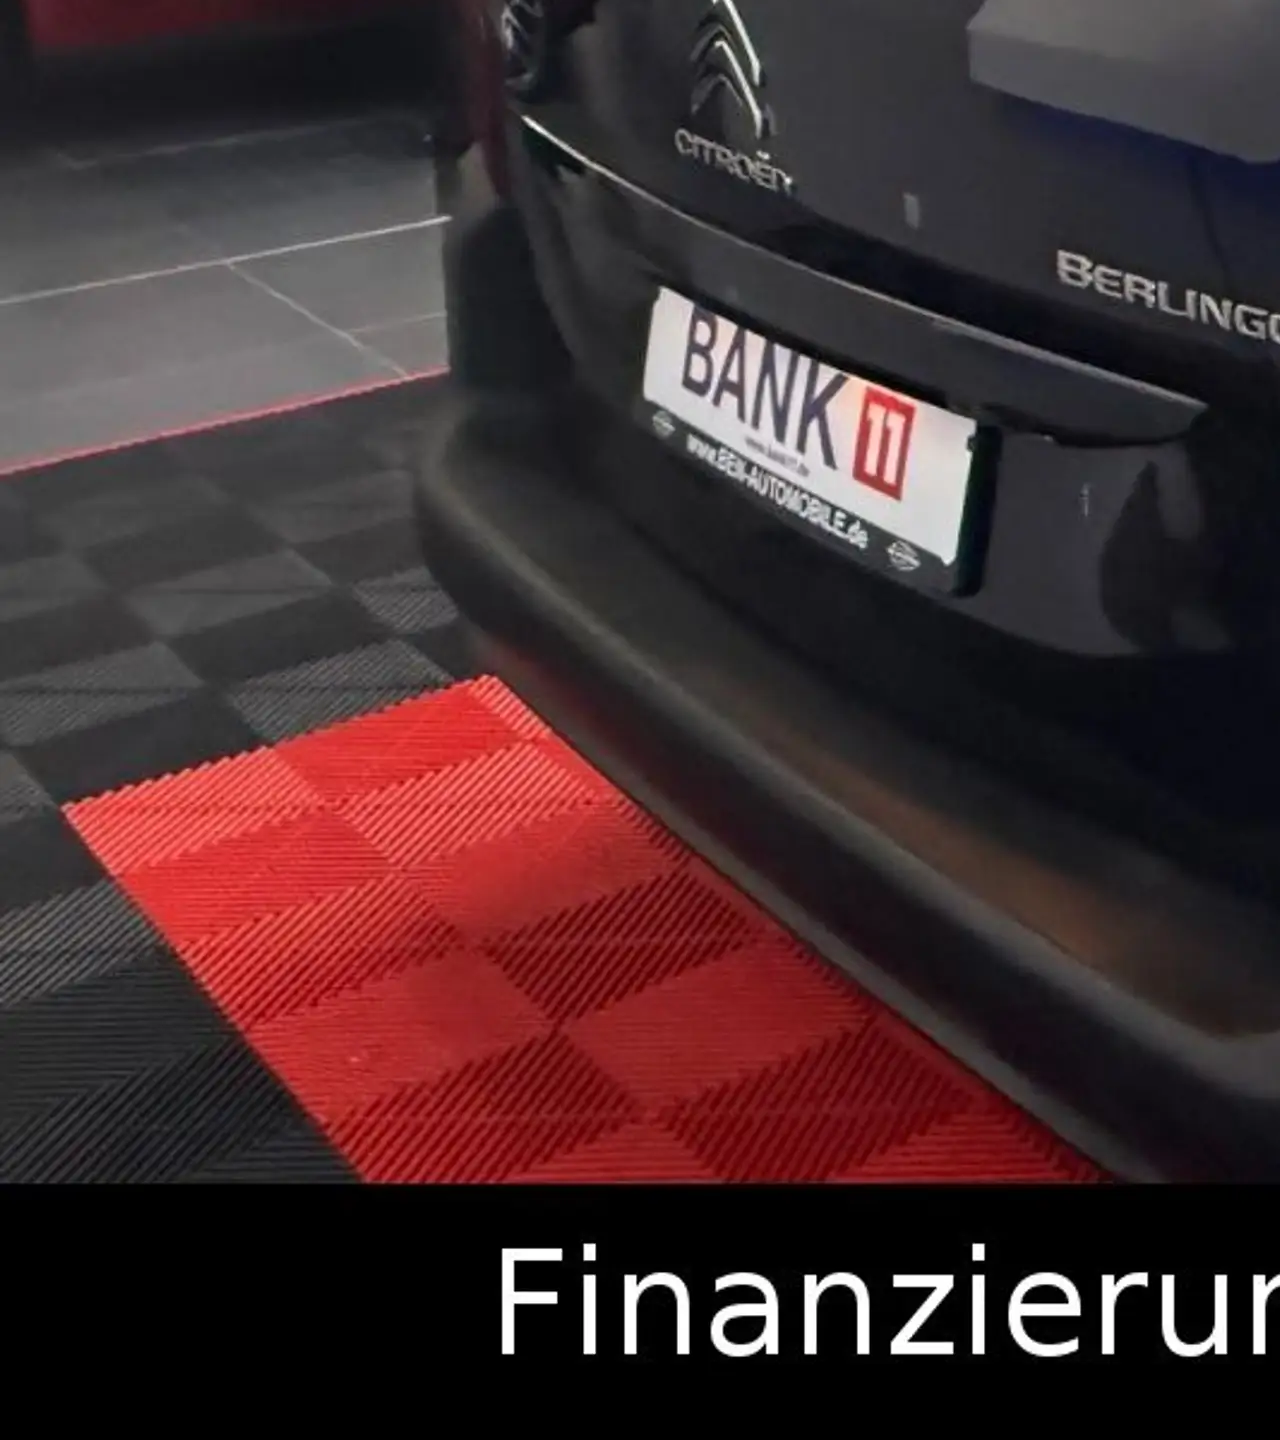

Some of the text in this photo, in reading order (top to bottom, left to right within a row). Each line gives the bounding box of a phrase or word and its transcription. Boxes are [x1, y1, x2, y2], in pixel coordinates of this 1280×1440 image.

[674, 127, 793, 197] CITROËN
[682, 306, 907, 489] BANK 11
